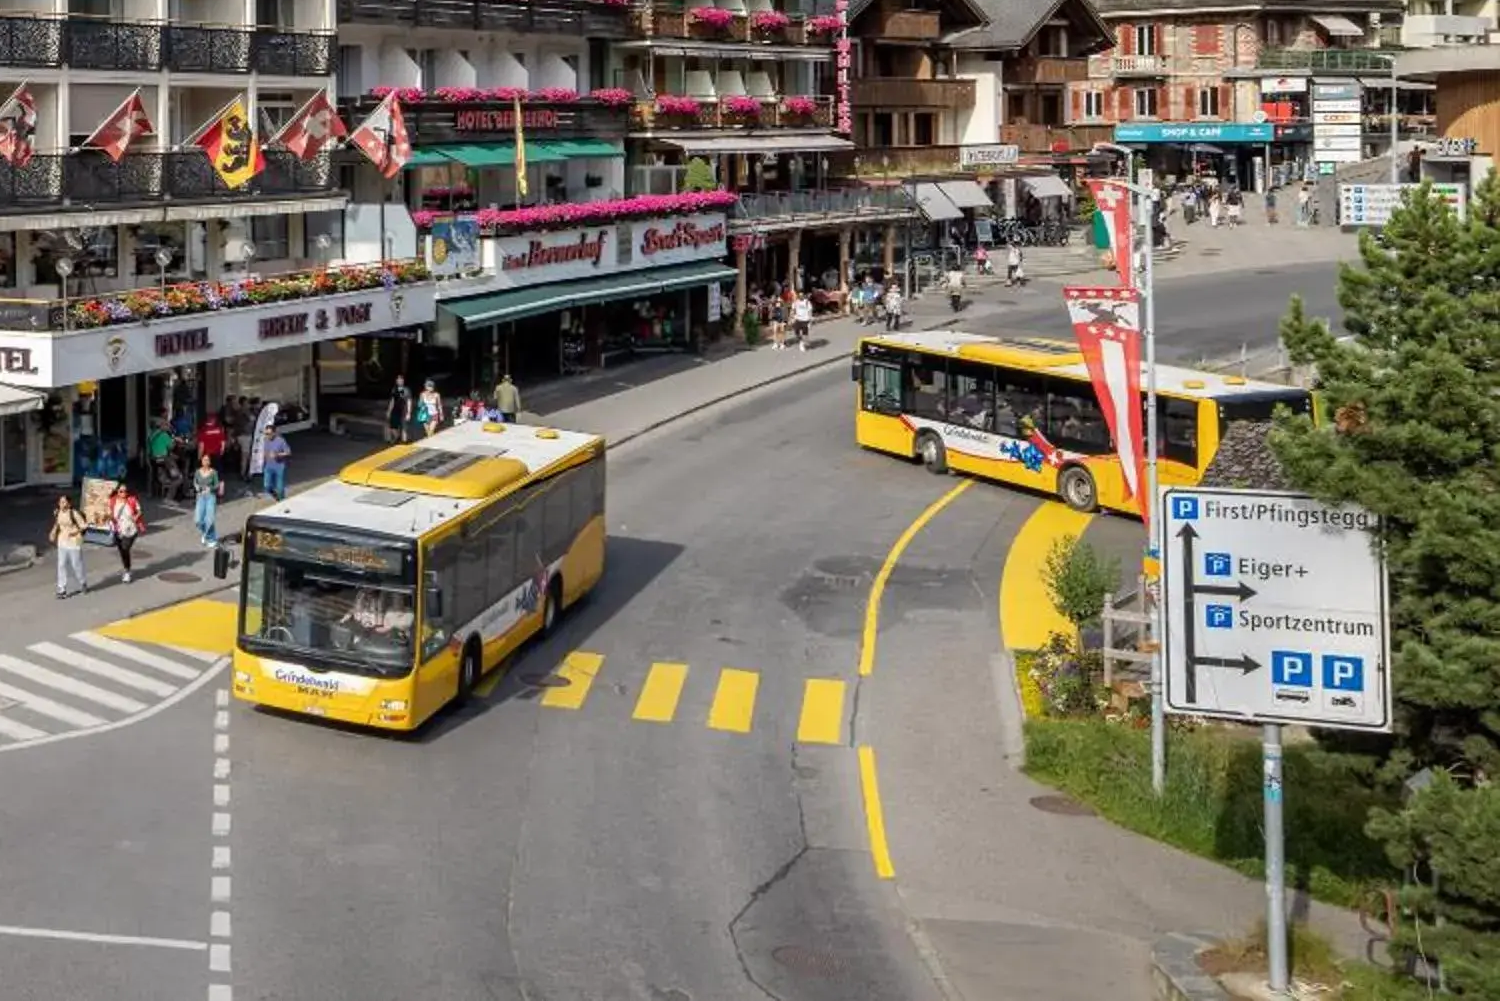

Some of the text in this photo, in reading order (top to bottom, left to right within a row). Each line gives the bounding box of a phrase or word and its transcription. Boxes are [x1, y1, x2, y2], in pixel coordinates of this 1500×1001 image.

[1161, 128, 1188, 138] SHOP
[155, 327, 214, 357] HOTEL
[315, 308, 329, 331] &
[336, 302, 373, 328] POST
[1205, 500, 1368, 530] First/Pfingstegg
[1239, 557, 1309, 580] Eiger+
[1239, 610, 1374, 636] Sportzentrum
[1283, 656, 1355, 687] P P
